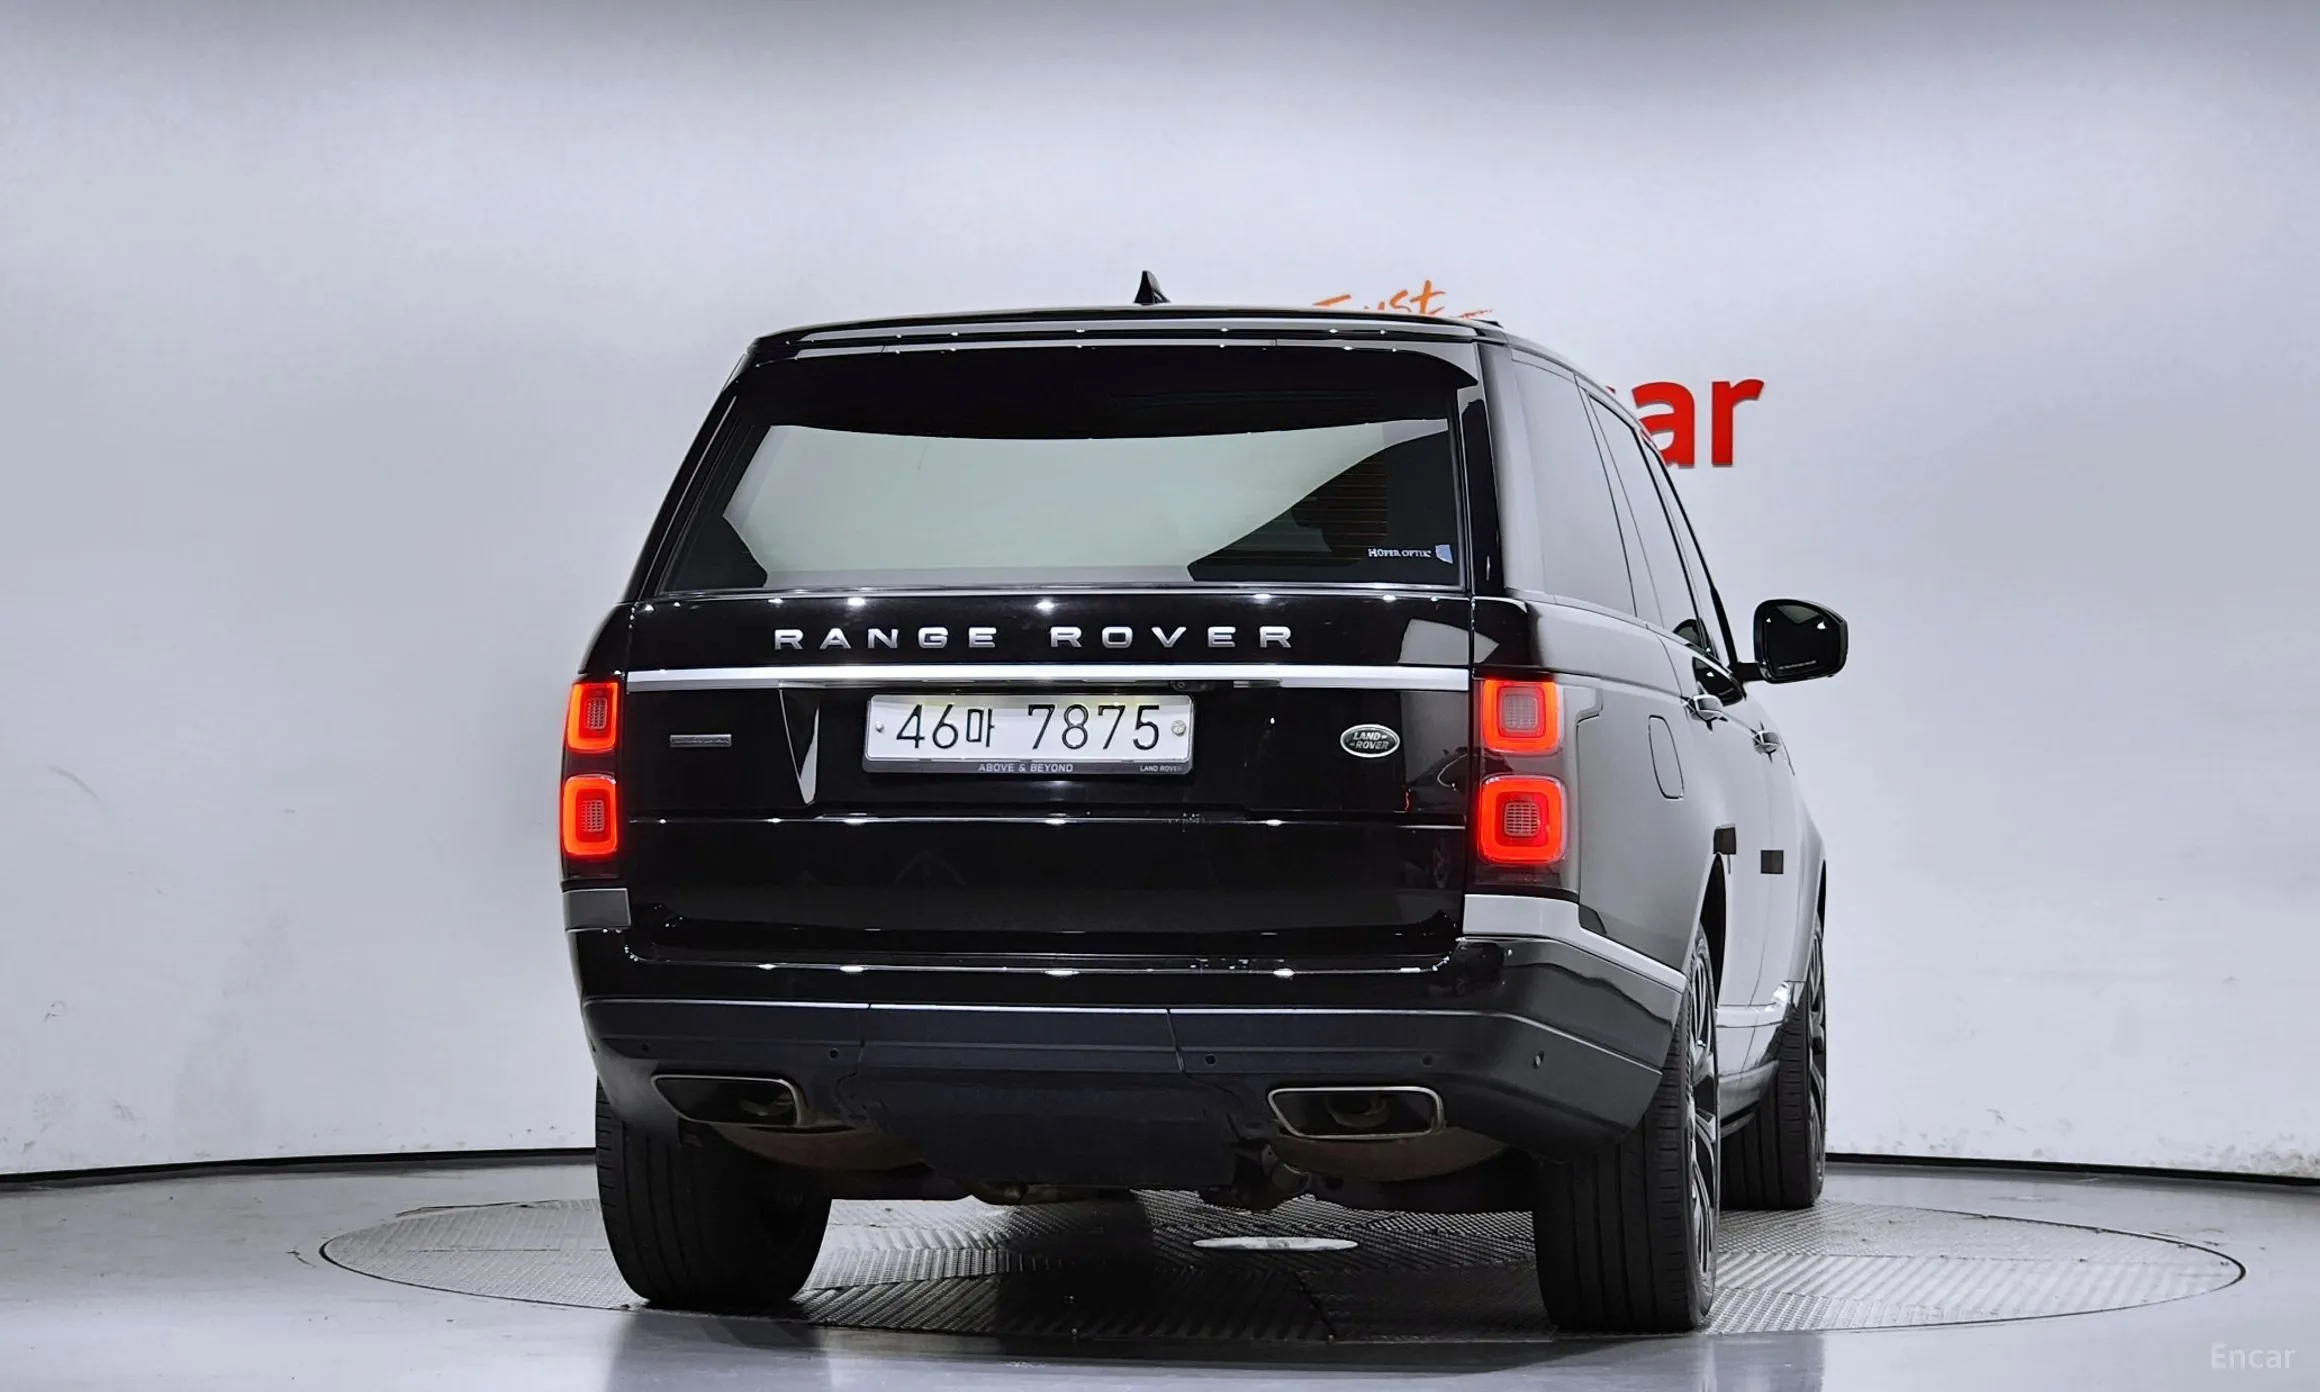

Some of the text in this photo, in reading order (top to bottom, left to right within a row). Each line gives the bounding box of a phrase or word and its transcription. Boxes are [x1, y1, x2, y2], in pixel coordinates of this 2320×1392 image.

[774, 626, 1292, 650] RANGE ROVER
[896, 704, 1160, 750] 46마 7875
[1353, 732, 1381, 741] LAND
[1355, 741, 1389, 750] ROVER
[978, 763, 1073, 773] ABOVE & BEYOND
